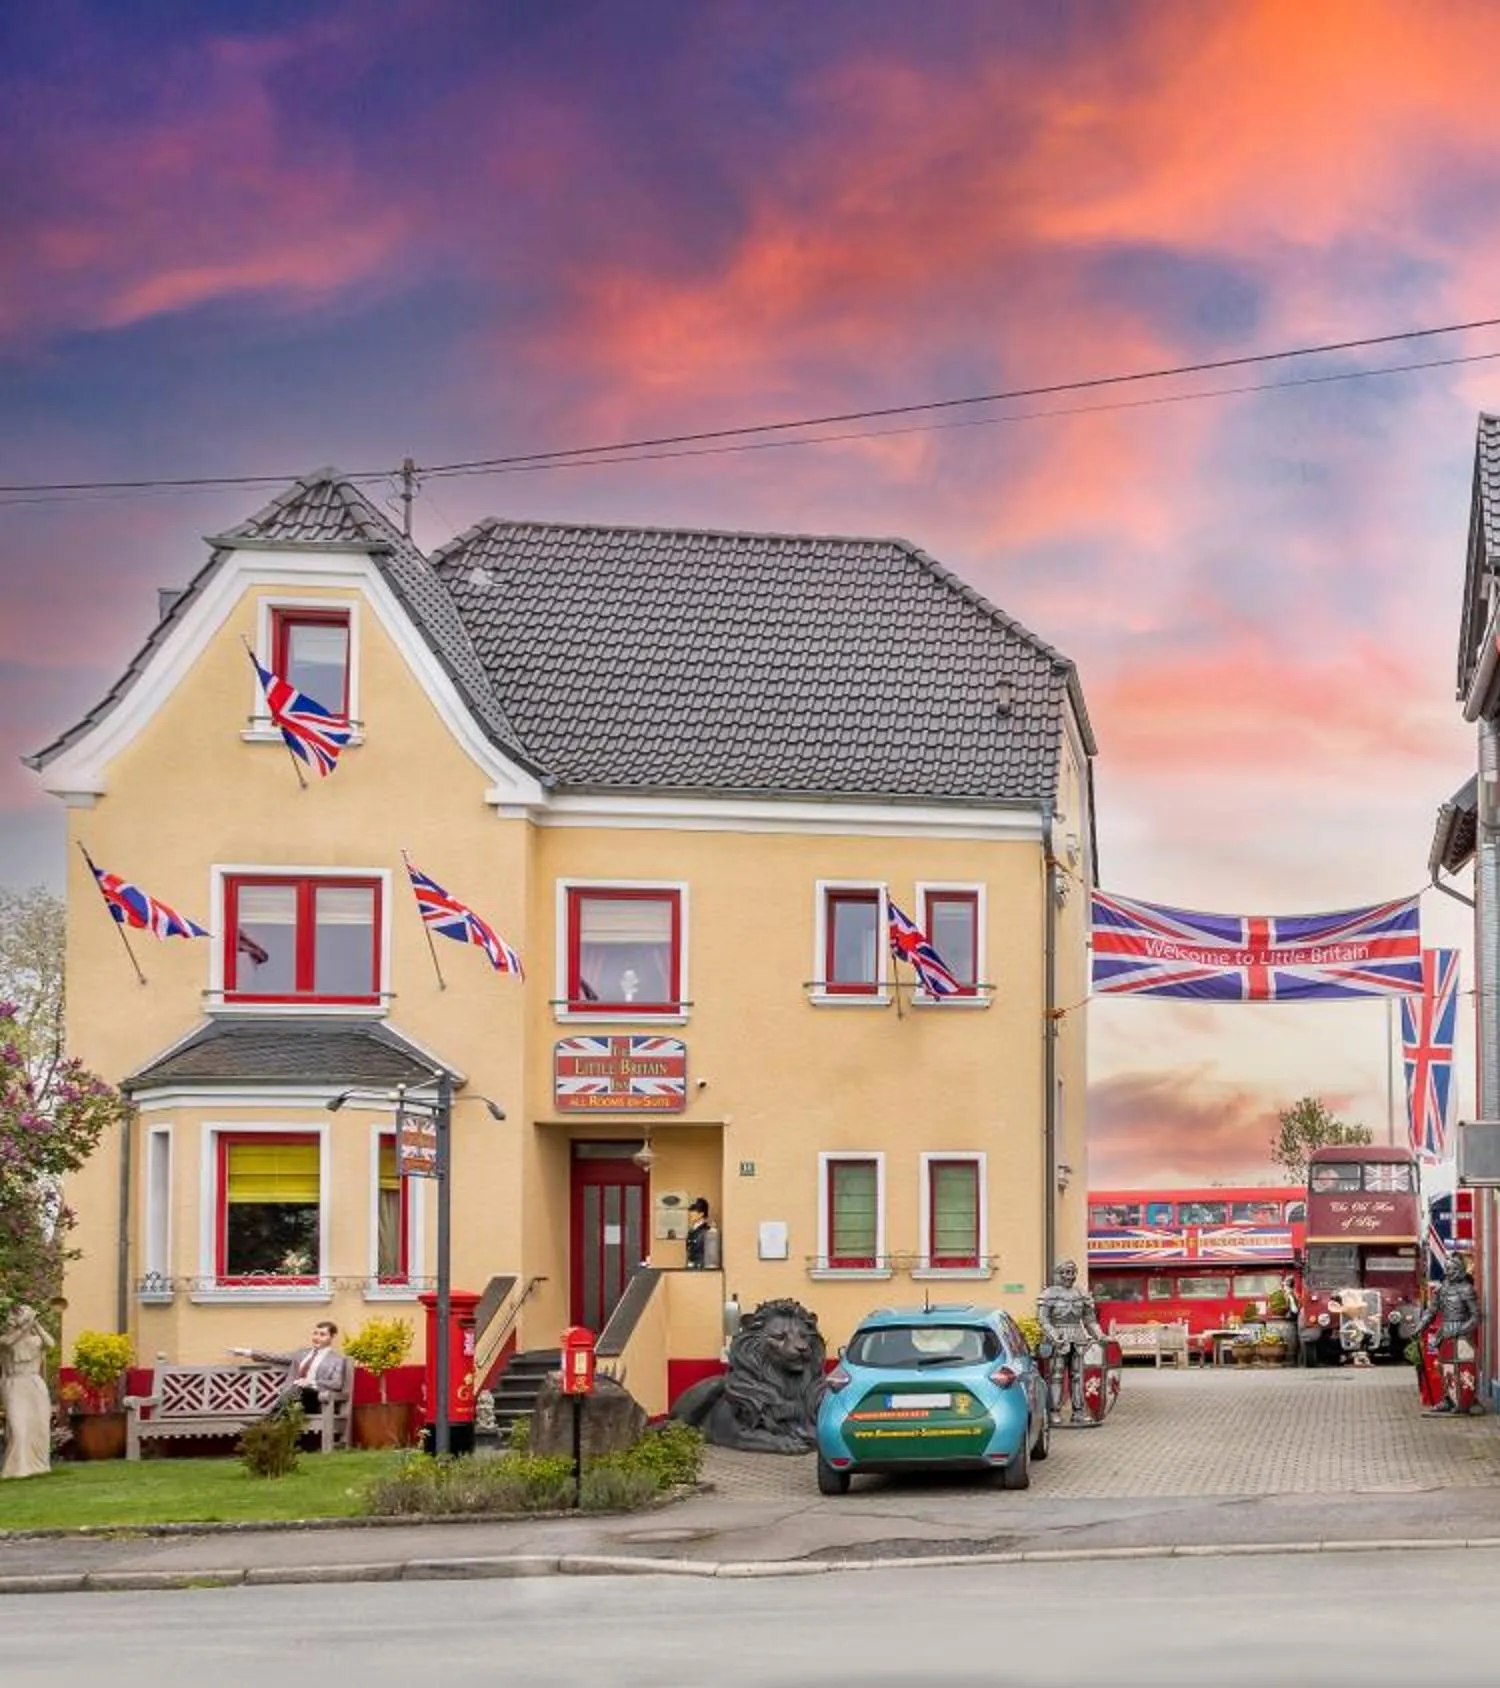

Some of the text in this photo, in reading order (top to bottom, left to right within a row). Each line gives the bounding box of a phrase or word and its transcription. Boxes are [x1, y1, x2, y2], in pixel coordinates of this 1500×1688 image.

[1145, 938, 1370, 966] Welcome to Little Britain
